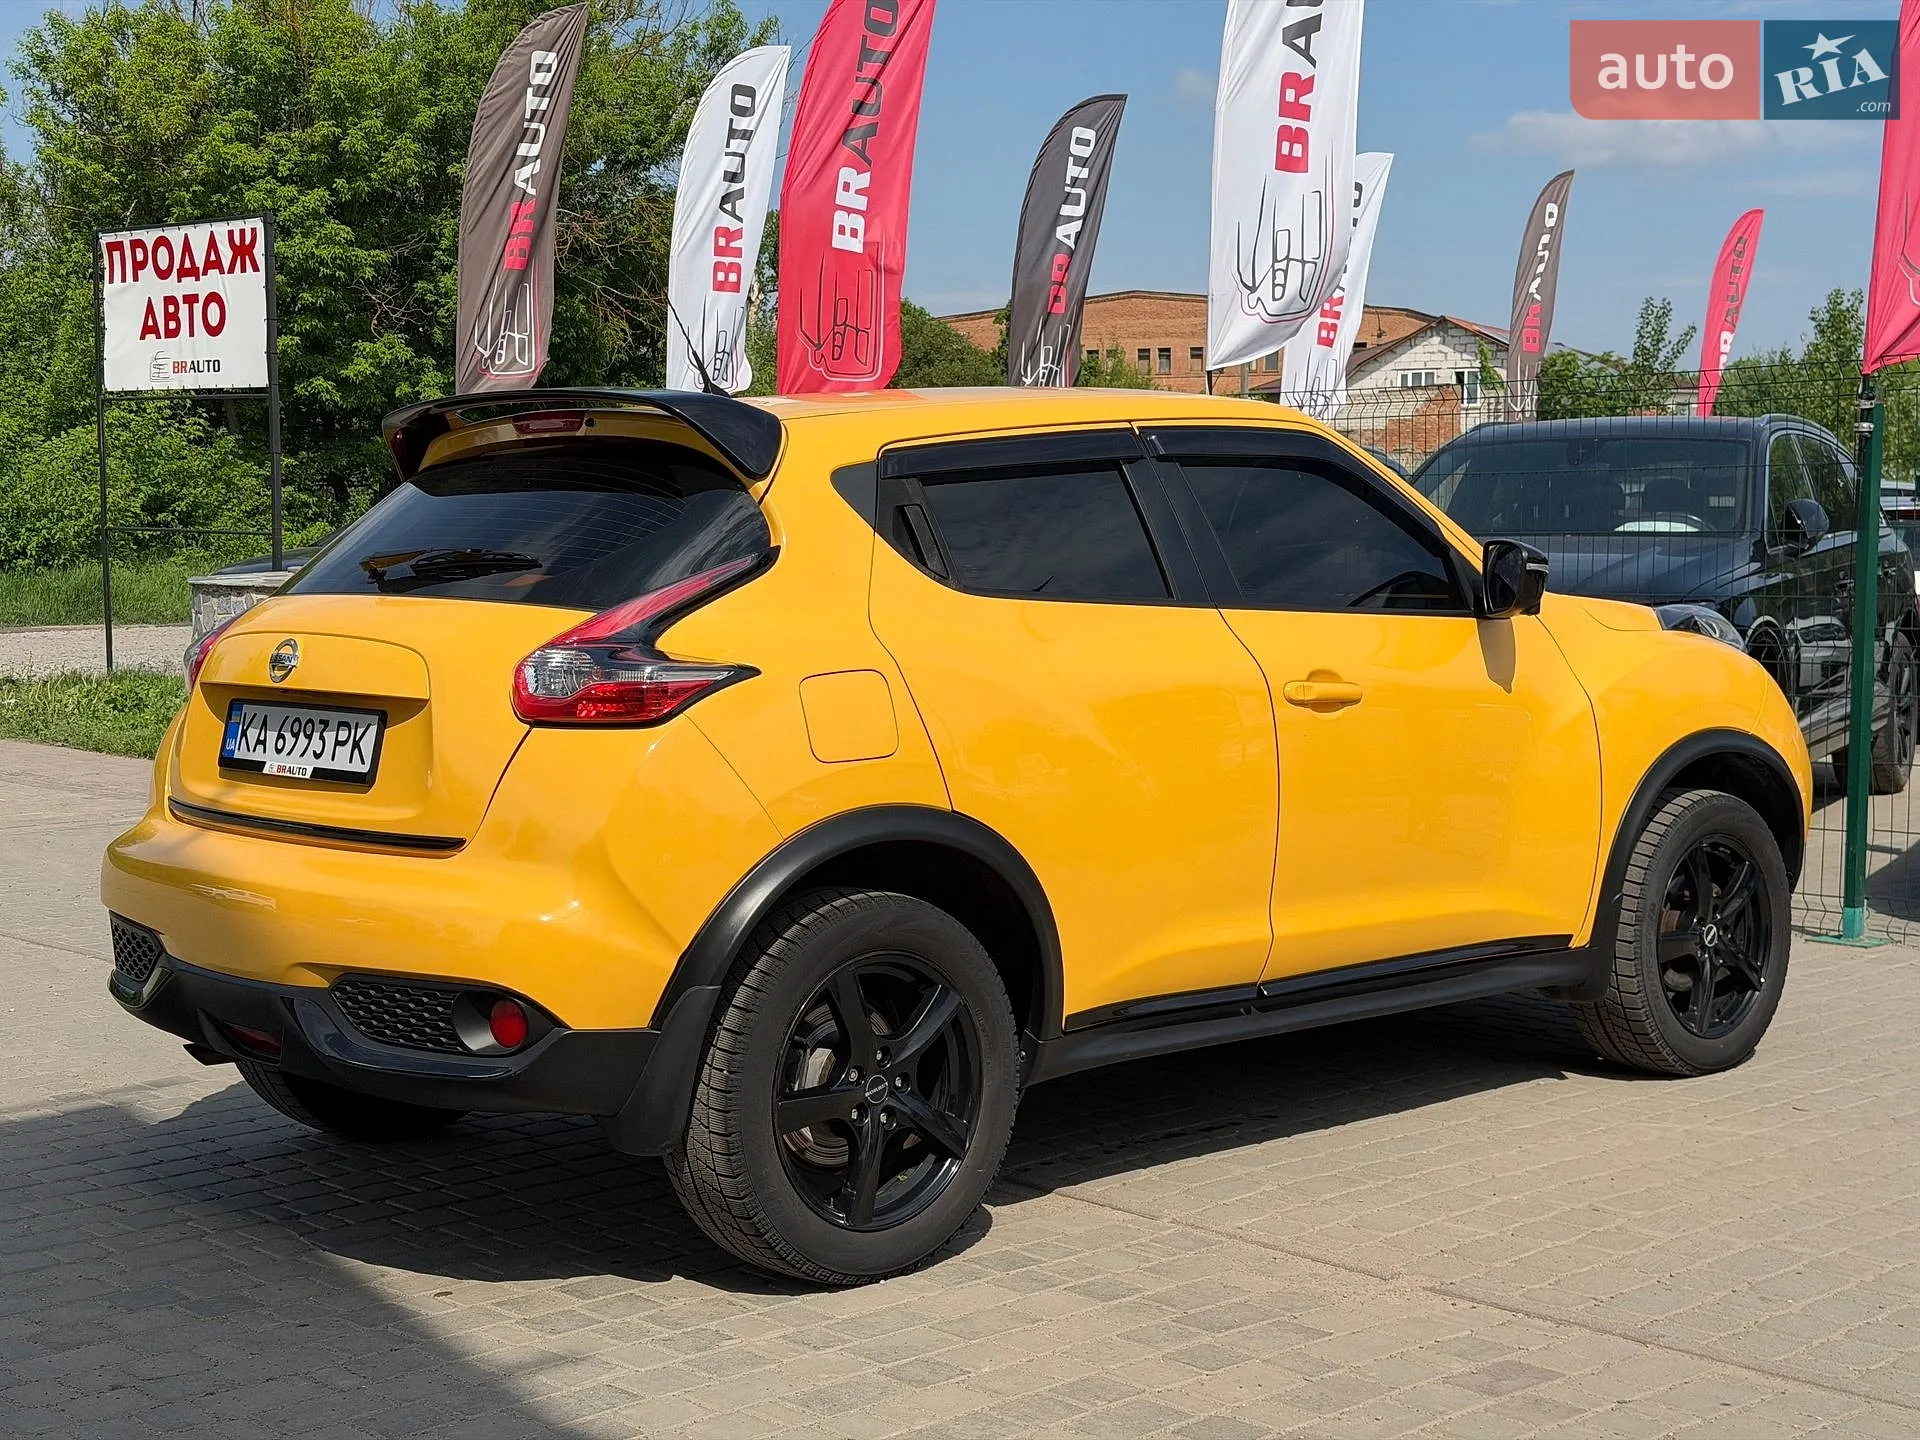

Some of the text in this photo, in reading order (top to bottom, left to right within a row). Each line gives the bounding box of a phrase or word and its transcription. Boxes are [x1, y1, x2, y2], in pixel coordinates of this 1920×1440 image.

[1275, 0, 1324, 174] BRA
[832, 0, 899, 254] BRAUTO
[503, 51, 558, 272] BRAUTO
[713, 83, 757, 294] BRAUTO
[105, 227, 261, 284] ПРОДАЖ
[139, 291, 227, 341] АВТО
[172, 358, 221, 374] BRAUTO
[225, 737, 236, 751] UA
[274, 715, 330, 760] 6993
[276, 764, 308, 778] BRAUTO
